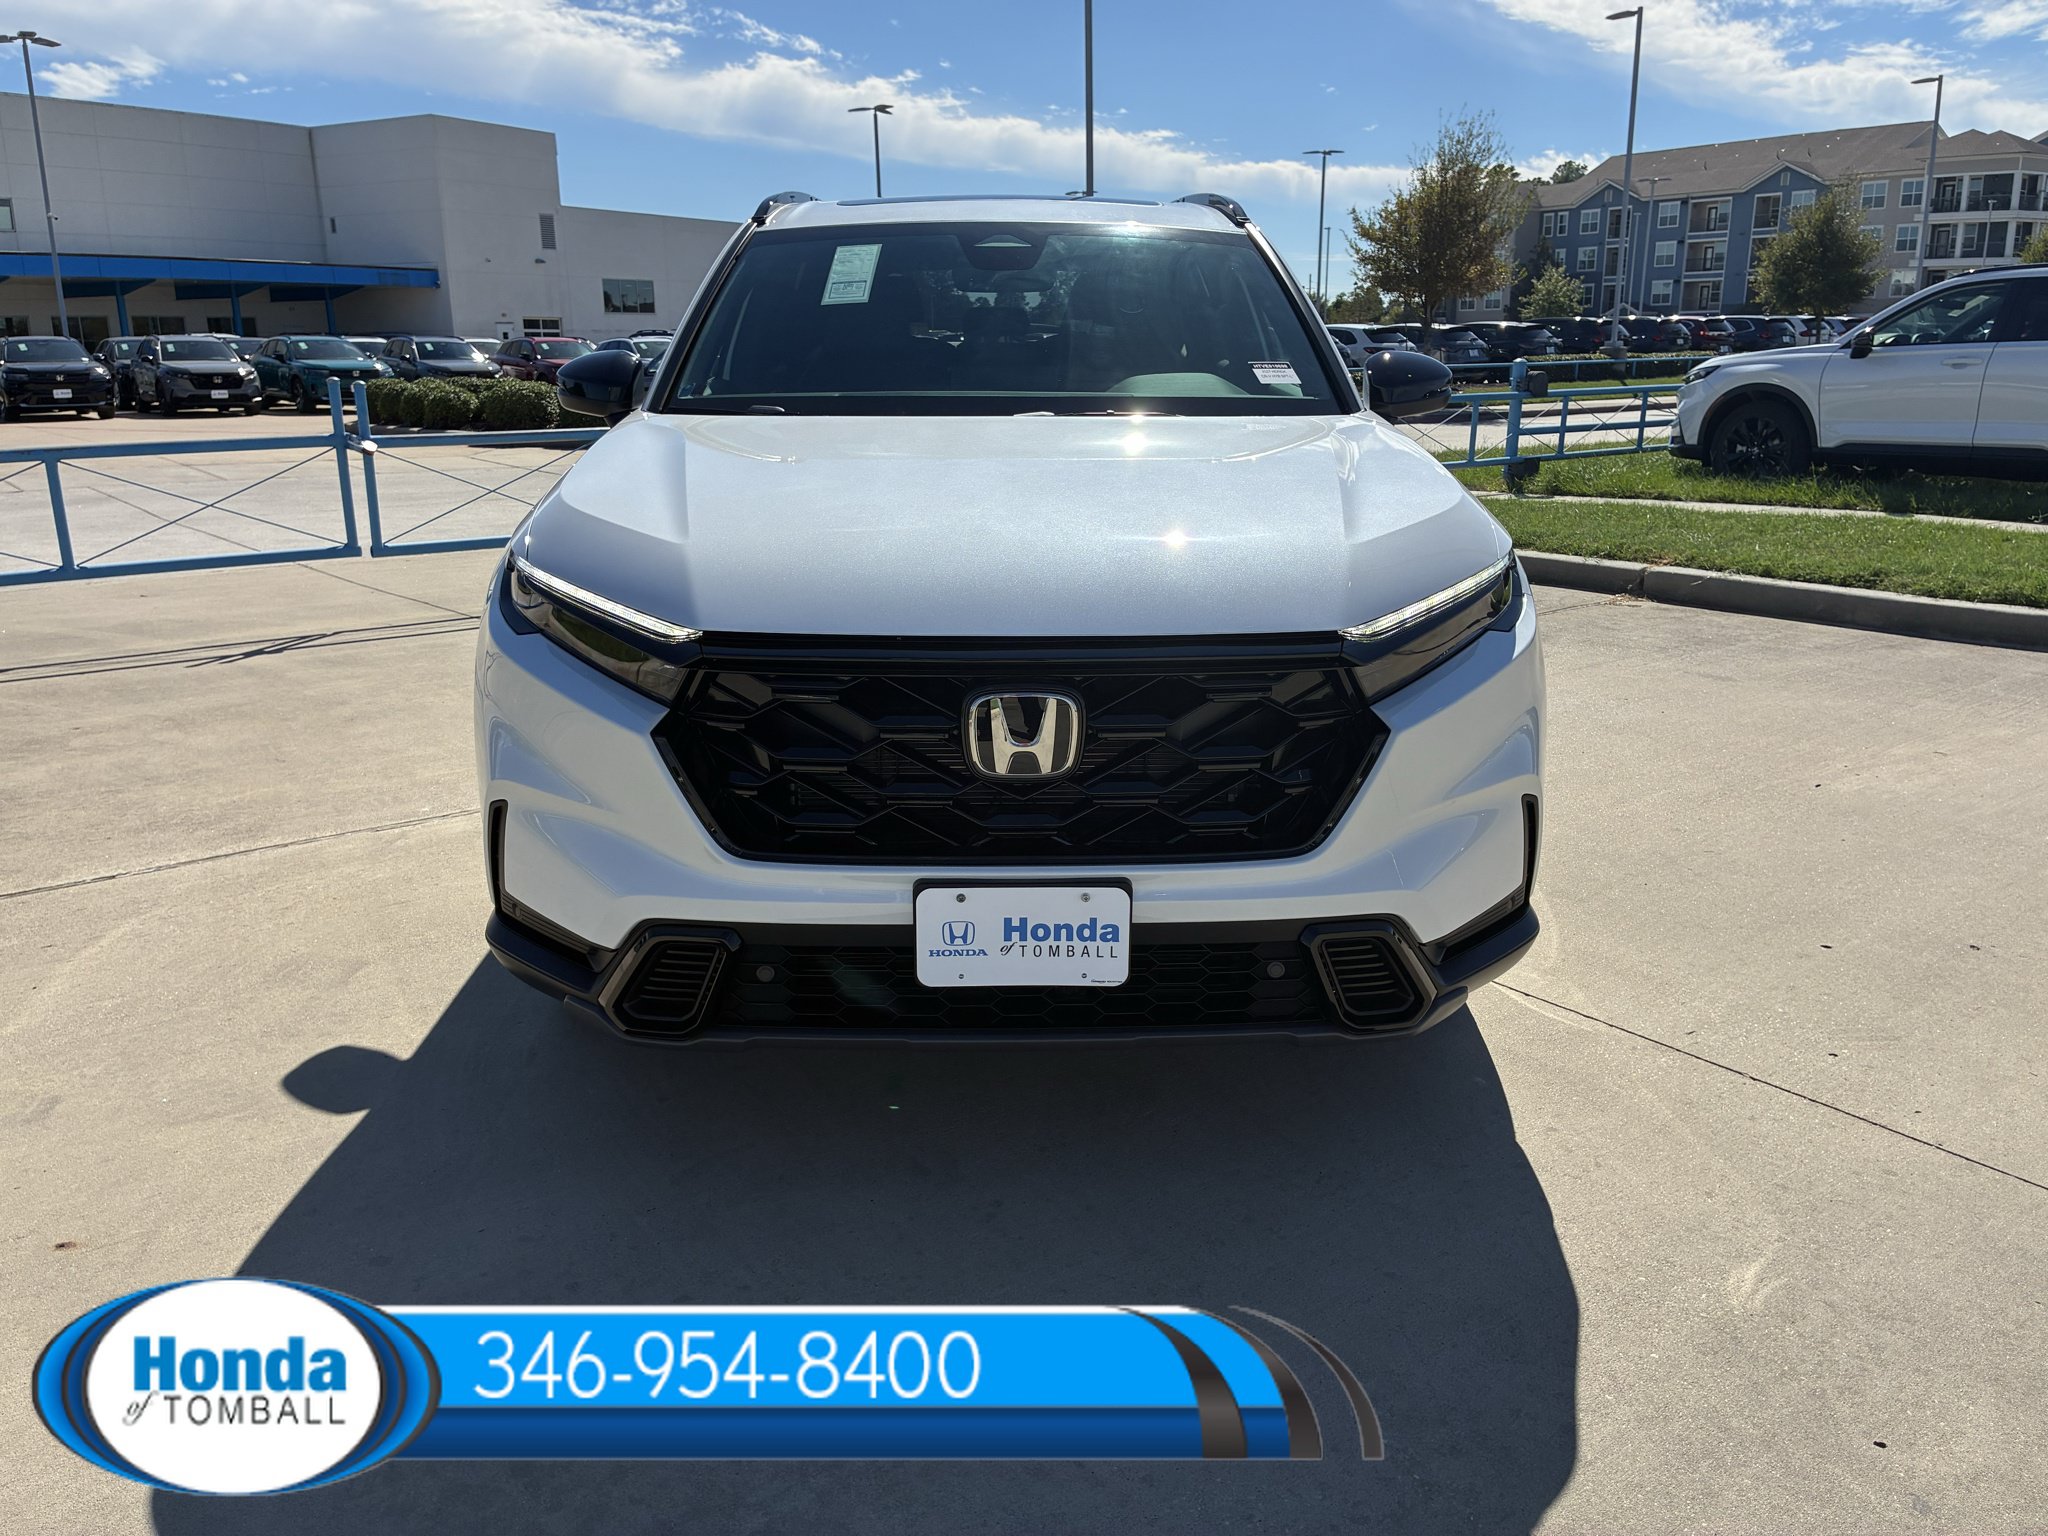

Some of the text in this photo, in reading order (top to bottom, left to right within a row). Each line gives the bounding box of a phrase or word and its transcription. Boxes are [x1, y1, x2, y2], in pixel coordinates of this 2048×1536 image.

[1003, 917, 1120, 942] Honda
[928, 949, 989, 957] HONDA
[1000, 941, 1118, 958] of TOMBALL
